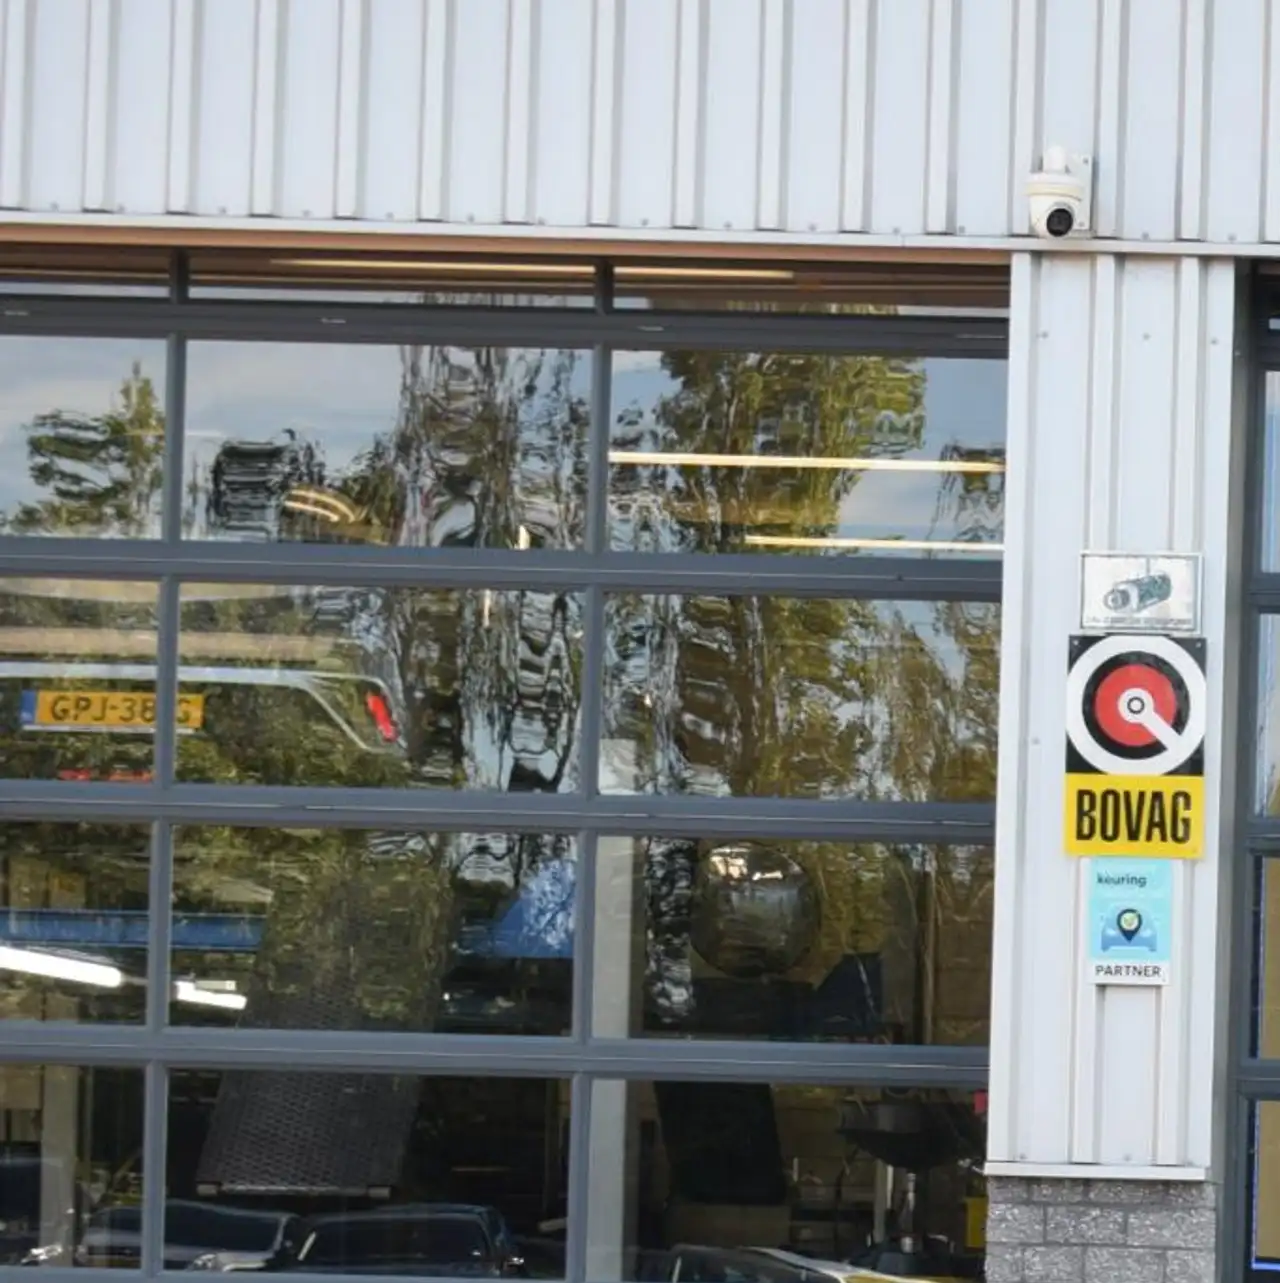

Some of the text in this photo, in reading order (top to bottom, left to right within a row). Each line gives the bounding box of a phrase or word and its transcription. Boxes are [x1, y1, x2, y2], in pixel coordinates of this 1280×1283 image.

[1076, 788, 1191, 844] BOVAG
[1097, 872, 1147, 888] keuring
[1095, 965, 1162, 977] PARTNER
